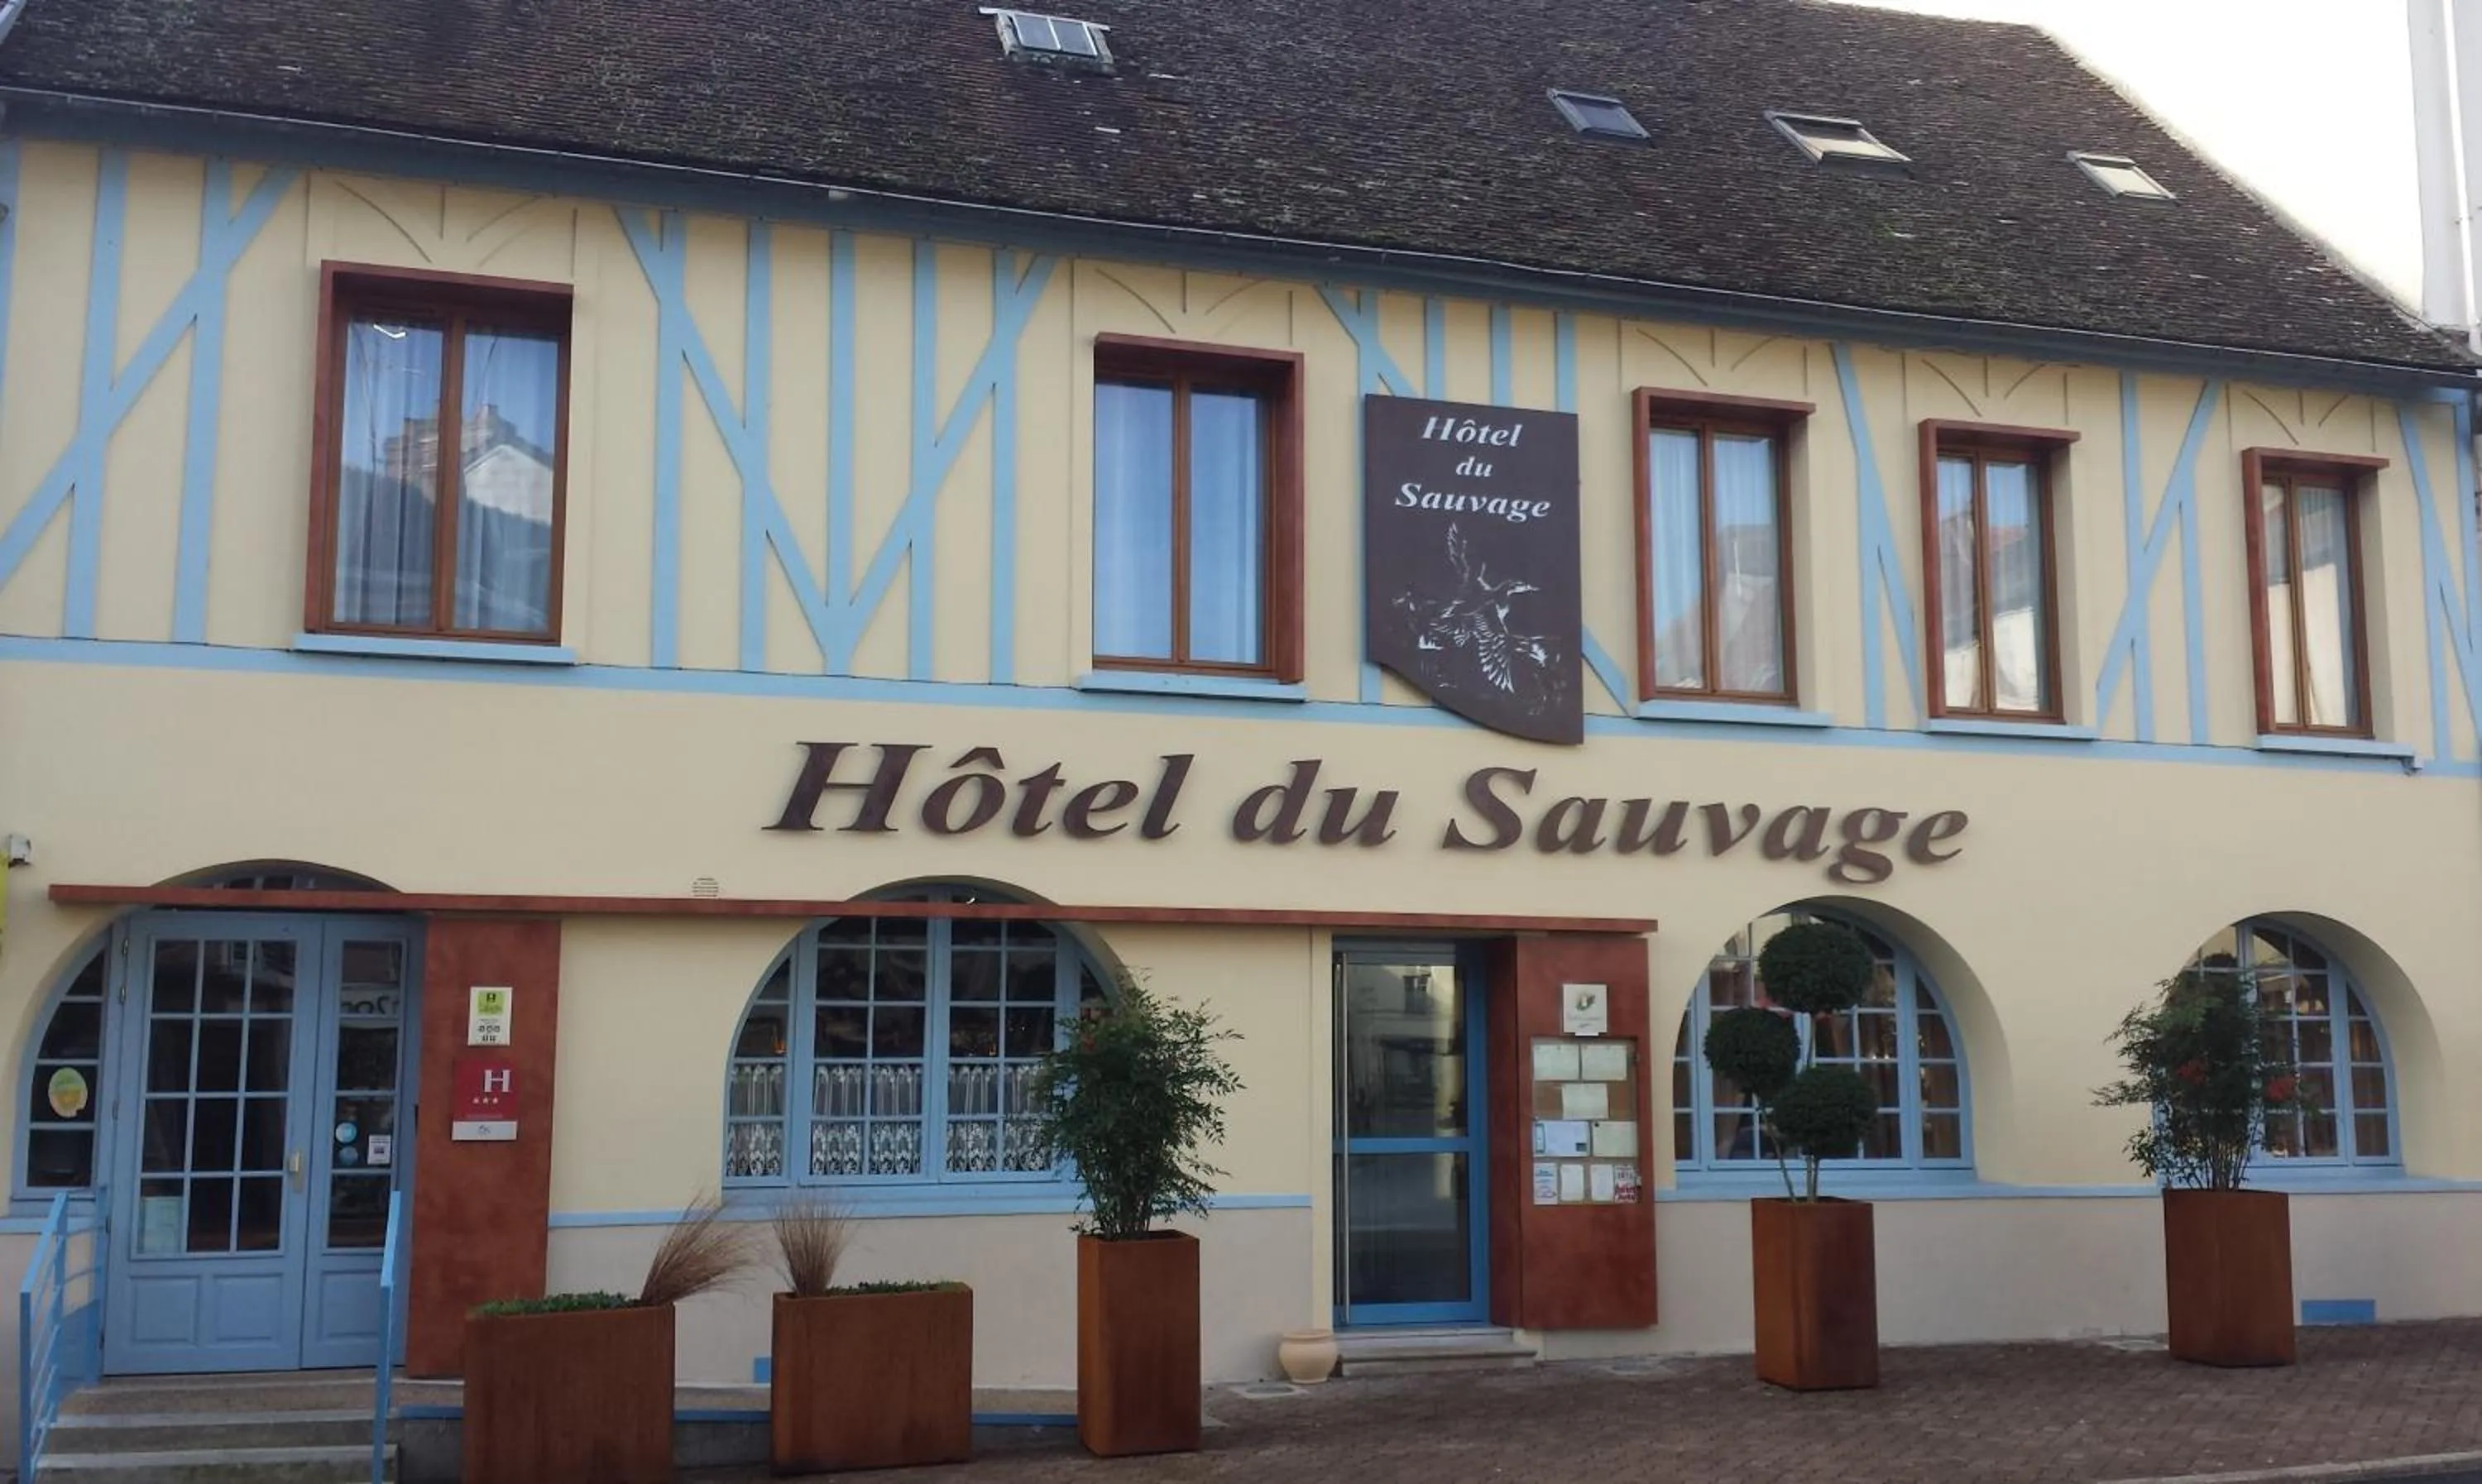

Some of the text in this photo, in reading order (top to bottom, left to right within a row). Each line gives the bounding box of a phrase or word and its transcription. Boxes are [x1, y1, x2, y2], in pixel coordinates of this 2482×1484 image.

[1421, 415, 1524, 448] Hôtel
[1454, 455, 1494, 478] du
[1394, 481, 1552, 523] Sauvage
[760, 740, 1969, 886] Hôtel du Sauvage
[483, 1069, 511, 1093] H
